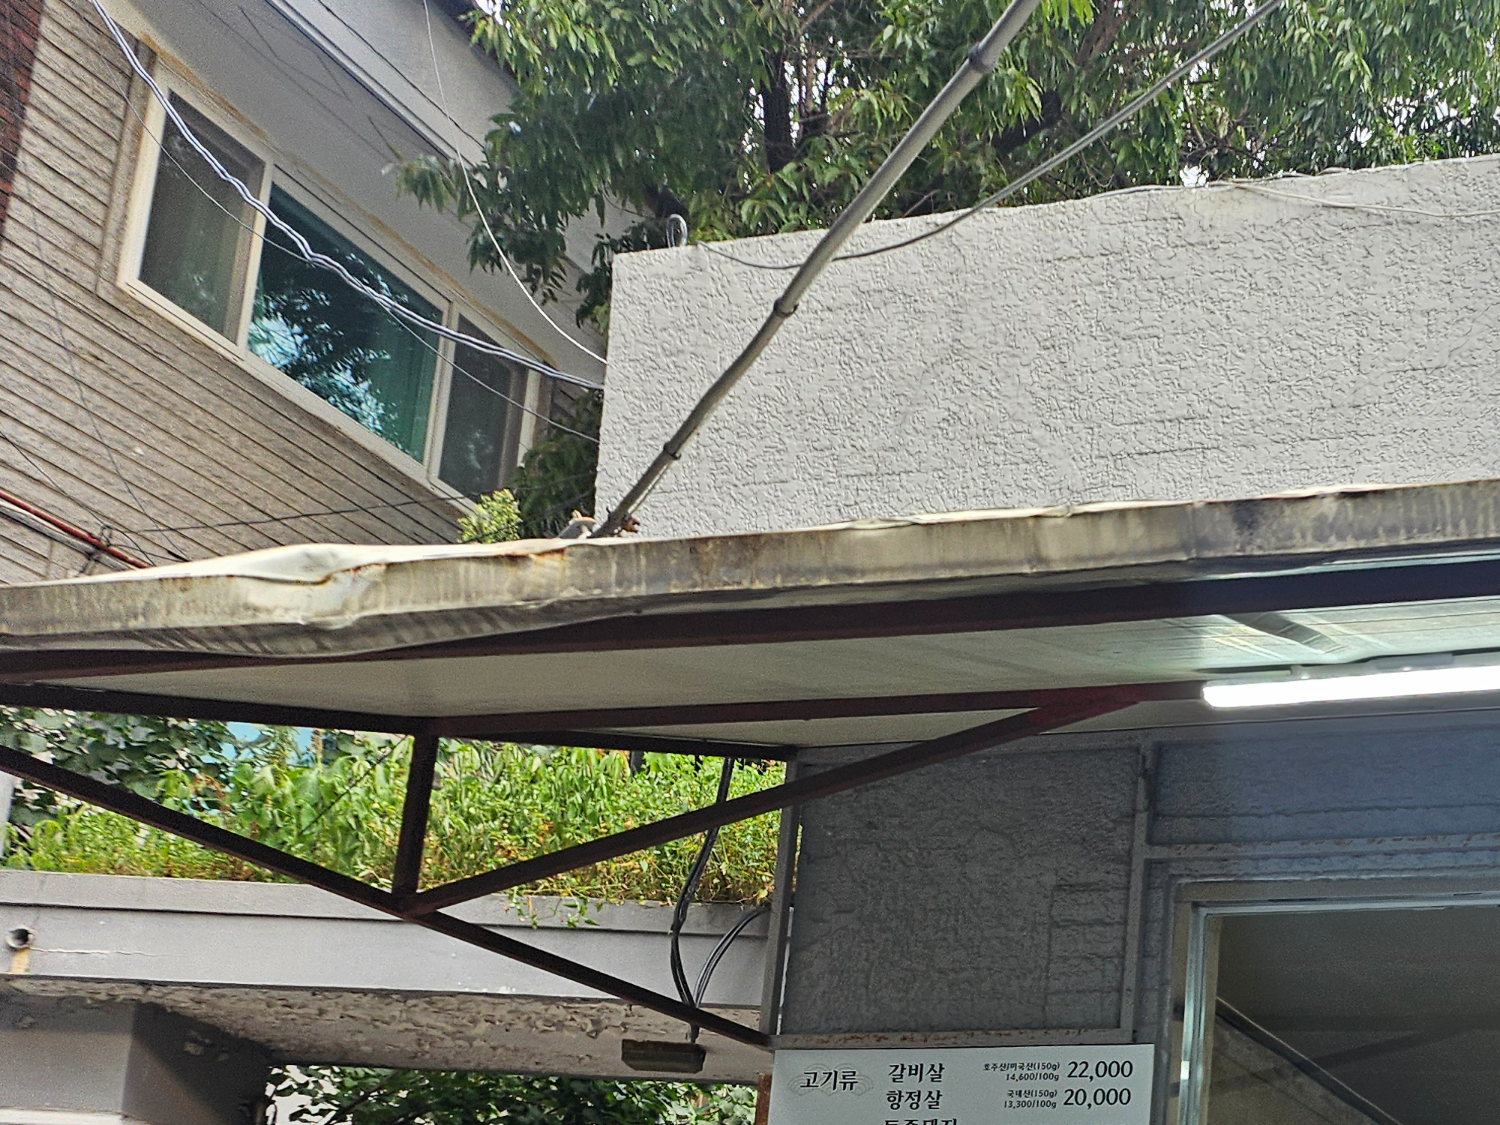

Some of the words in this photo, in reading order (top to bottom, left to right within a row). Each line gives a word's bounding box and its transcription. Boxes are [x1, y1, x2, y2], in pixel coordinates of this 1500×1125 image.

[799, 1069, 859, 1091] 고기류
[888, 1062, 946, 1084] 갈비살
[1066, 1060, 1134, 1083] 22,000
[1006, 1072, 1060, 1082] 14,600/100g
[886, 1089, 943, 1111] 항정살
[1007, 1089, 1058, 1099] 국내산(150g)
[1063, 1087, 1132, 1110] 20,000
[1004, 1099, 1057, 1109] 13,300/100g
